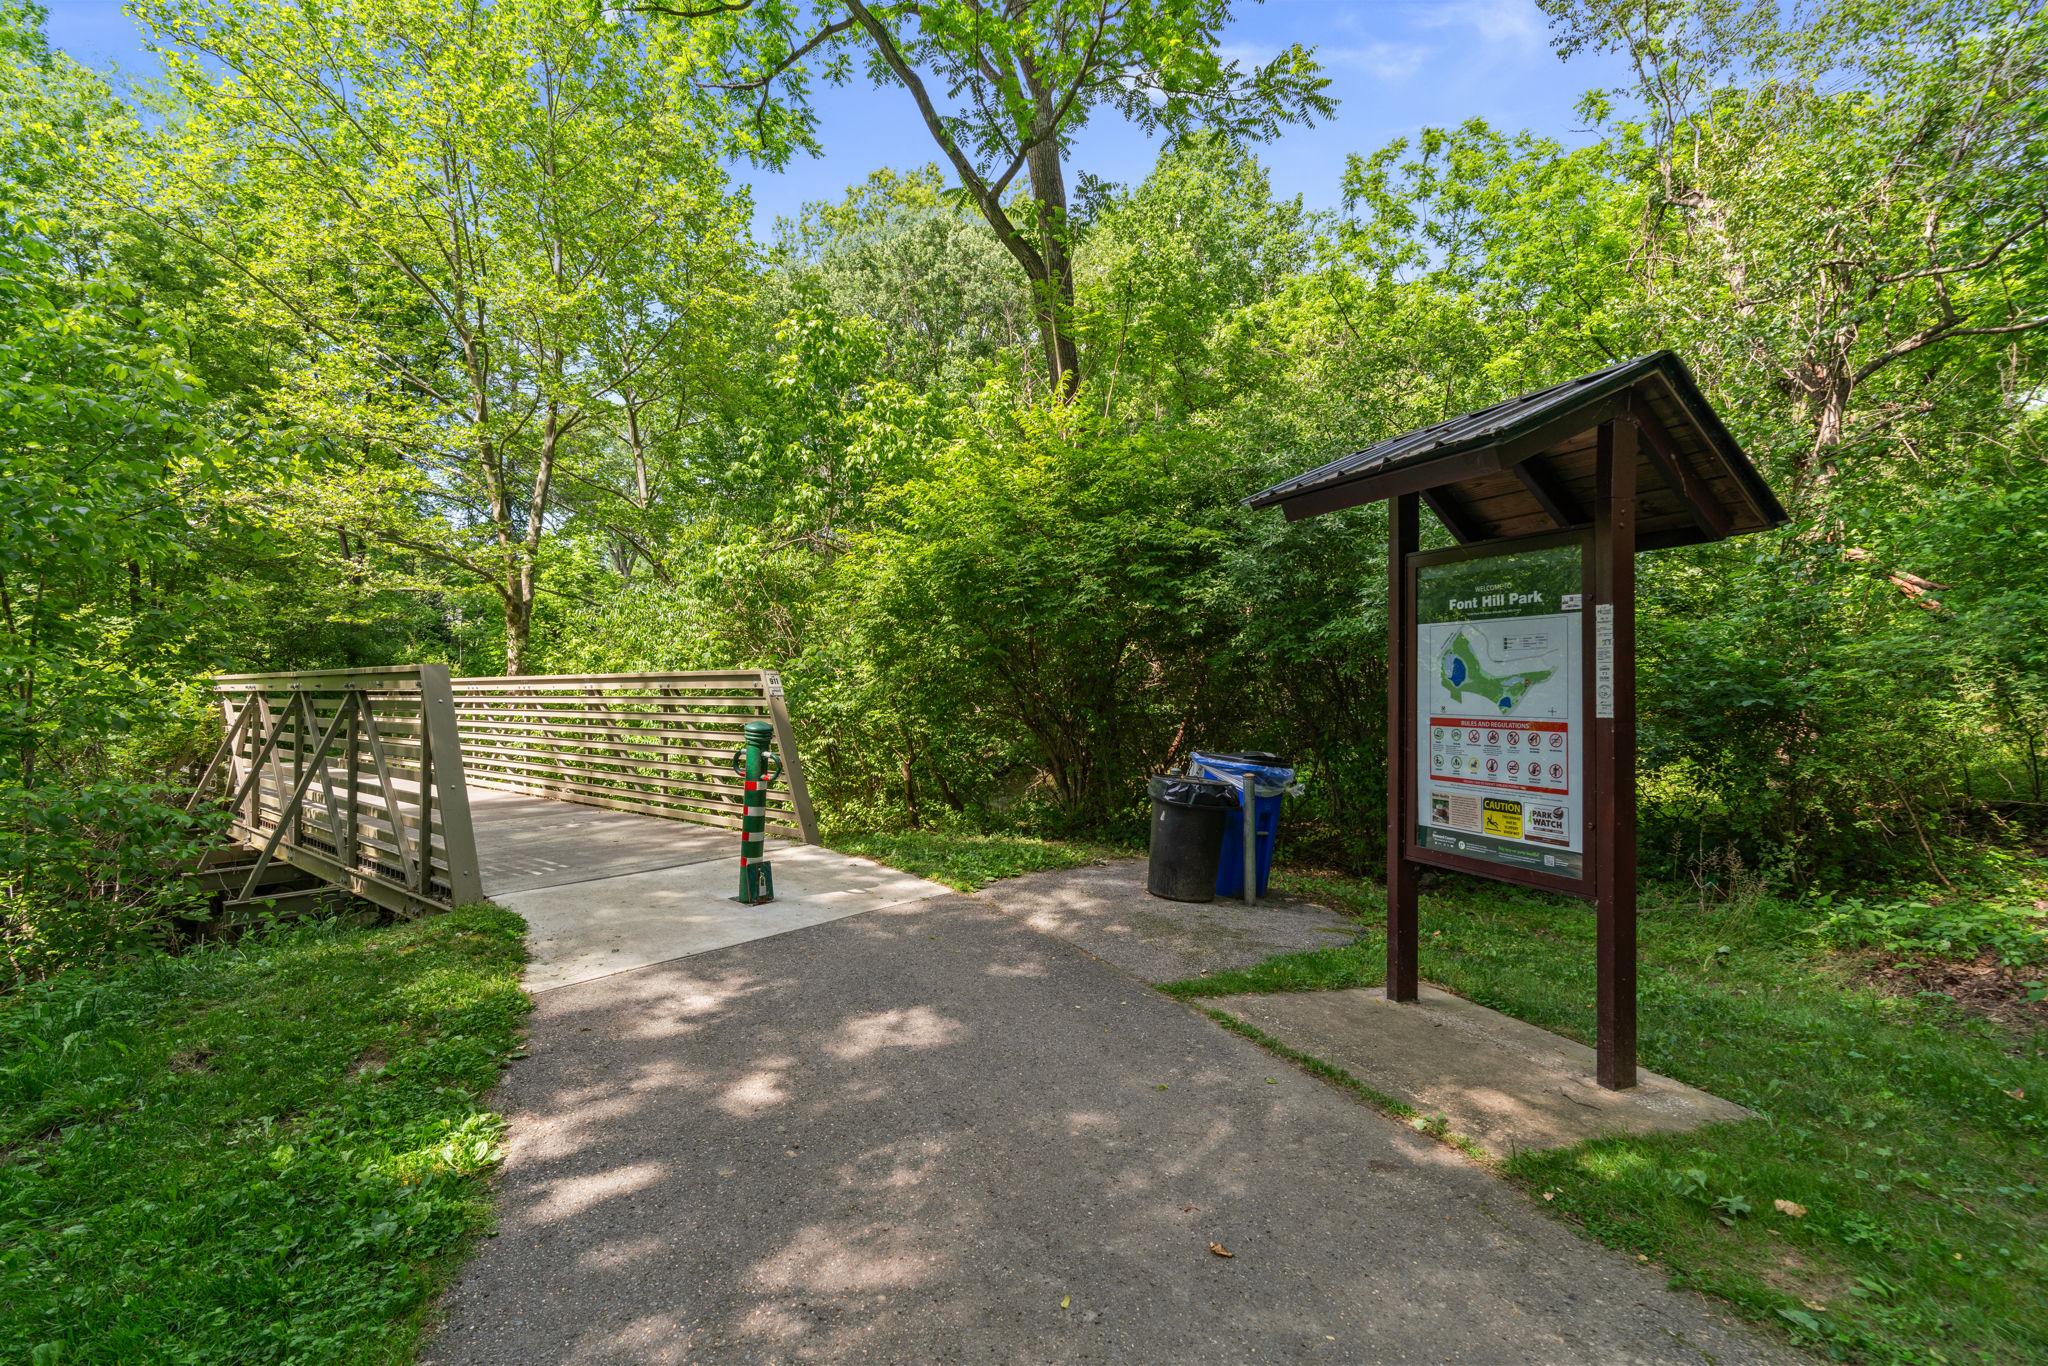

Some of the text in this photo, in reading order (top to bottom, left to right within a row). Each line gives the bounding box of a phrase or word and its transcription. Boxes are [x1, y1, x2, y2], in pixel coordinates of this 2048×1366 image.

[1474, 583, 1504, 592] WELCOME
[1449, 590, 1543, 610] Font Hill Park
[1490, 721, 1530, 729] REGULATIONS
[1484, 800, 1521, 813] CAUTION
[1532, 810, 1552, 819] PARK
[1533, 818, 1562, 829] WATCH
